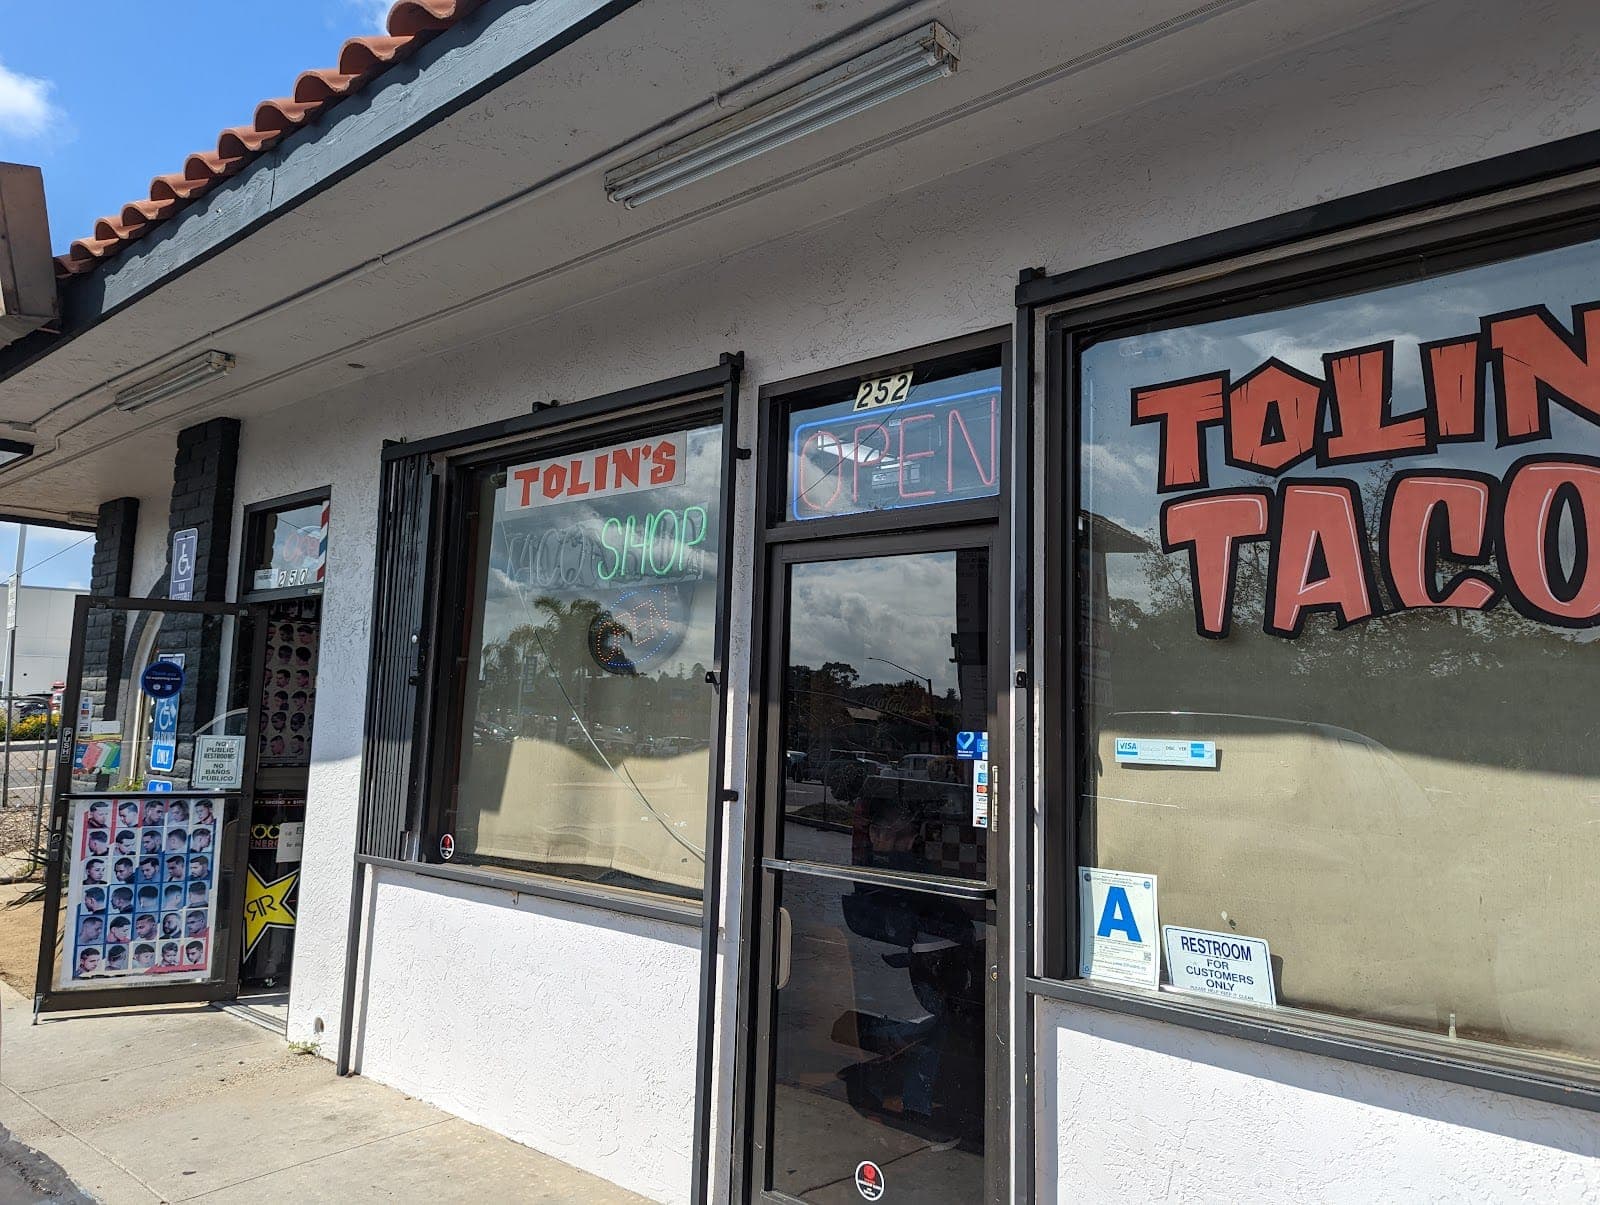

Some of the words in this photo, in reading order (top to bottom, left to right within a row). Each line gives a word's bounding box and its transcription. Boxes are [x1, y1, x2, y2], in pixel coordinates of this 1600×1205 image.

[857, 374, 909, 409] 252
[800, 397, 996, 511] OPEN
[514, 440, 676, 507] TOLIN'S
[597, 505, 708, 581] SHOP
[1160, 453, 1600, 639] TACO
[278, 569, 308, 587] 250
[62, 730, 71, 755] PUSH
[1120, 742, 1137, 750] VISA
[156, 749, 169, 764] ONLY
[1097, 885, 1143, 943] A
[1180, 935, 1253, 962] RESTROOM
[1185, 965, 1255, 986] CUSTOMERS
[1206, 958, 1230, 971] FOR
[1206, 979, 1236, 992] ONLY
[1238, 993, 1255, 1001] CLEAN
